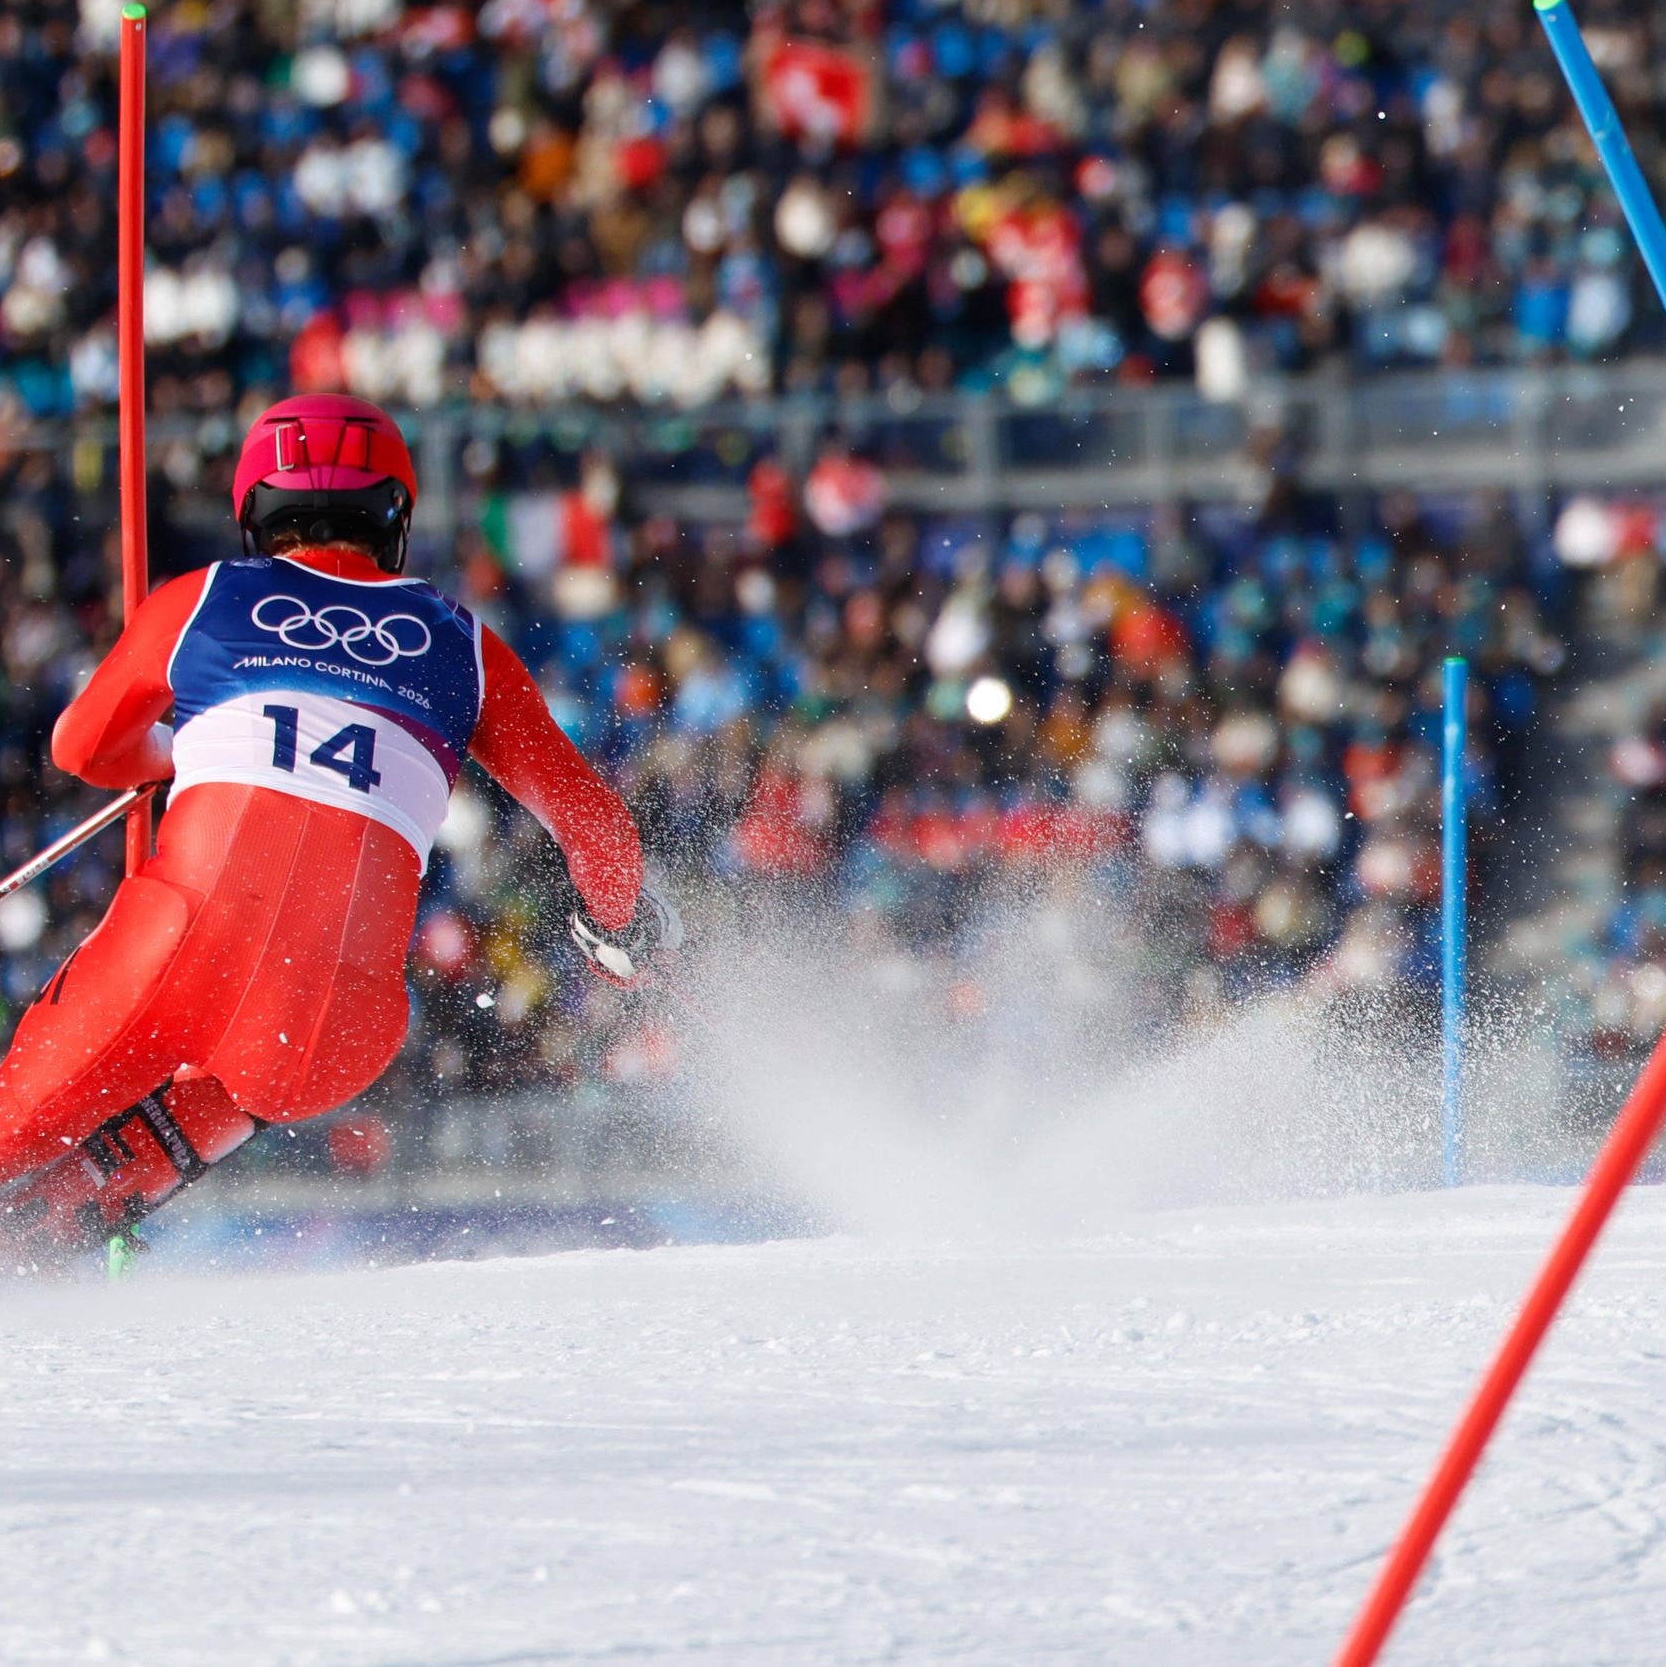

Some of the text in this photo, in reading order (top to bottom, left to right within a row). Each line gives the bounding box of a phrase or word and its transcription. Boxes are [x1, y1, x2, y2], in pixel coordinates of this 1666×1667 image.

[233, 656, 431, 710] MILANO CORTINA 2026
[262, 704, 382, 795] 14
